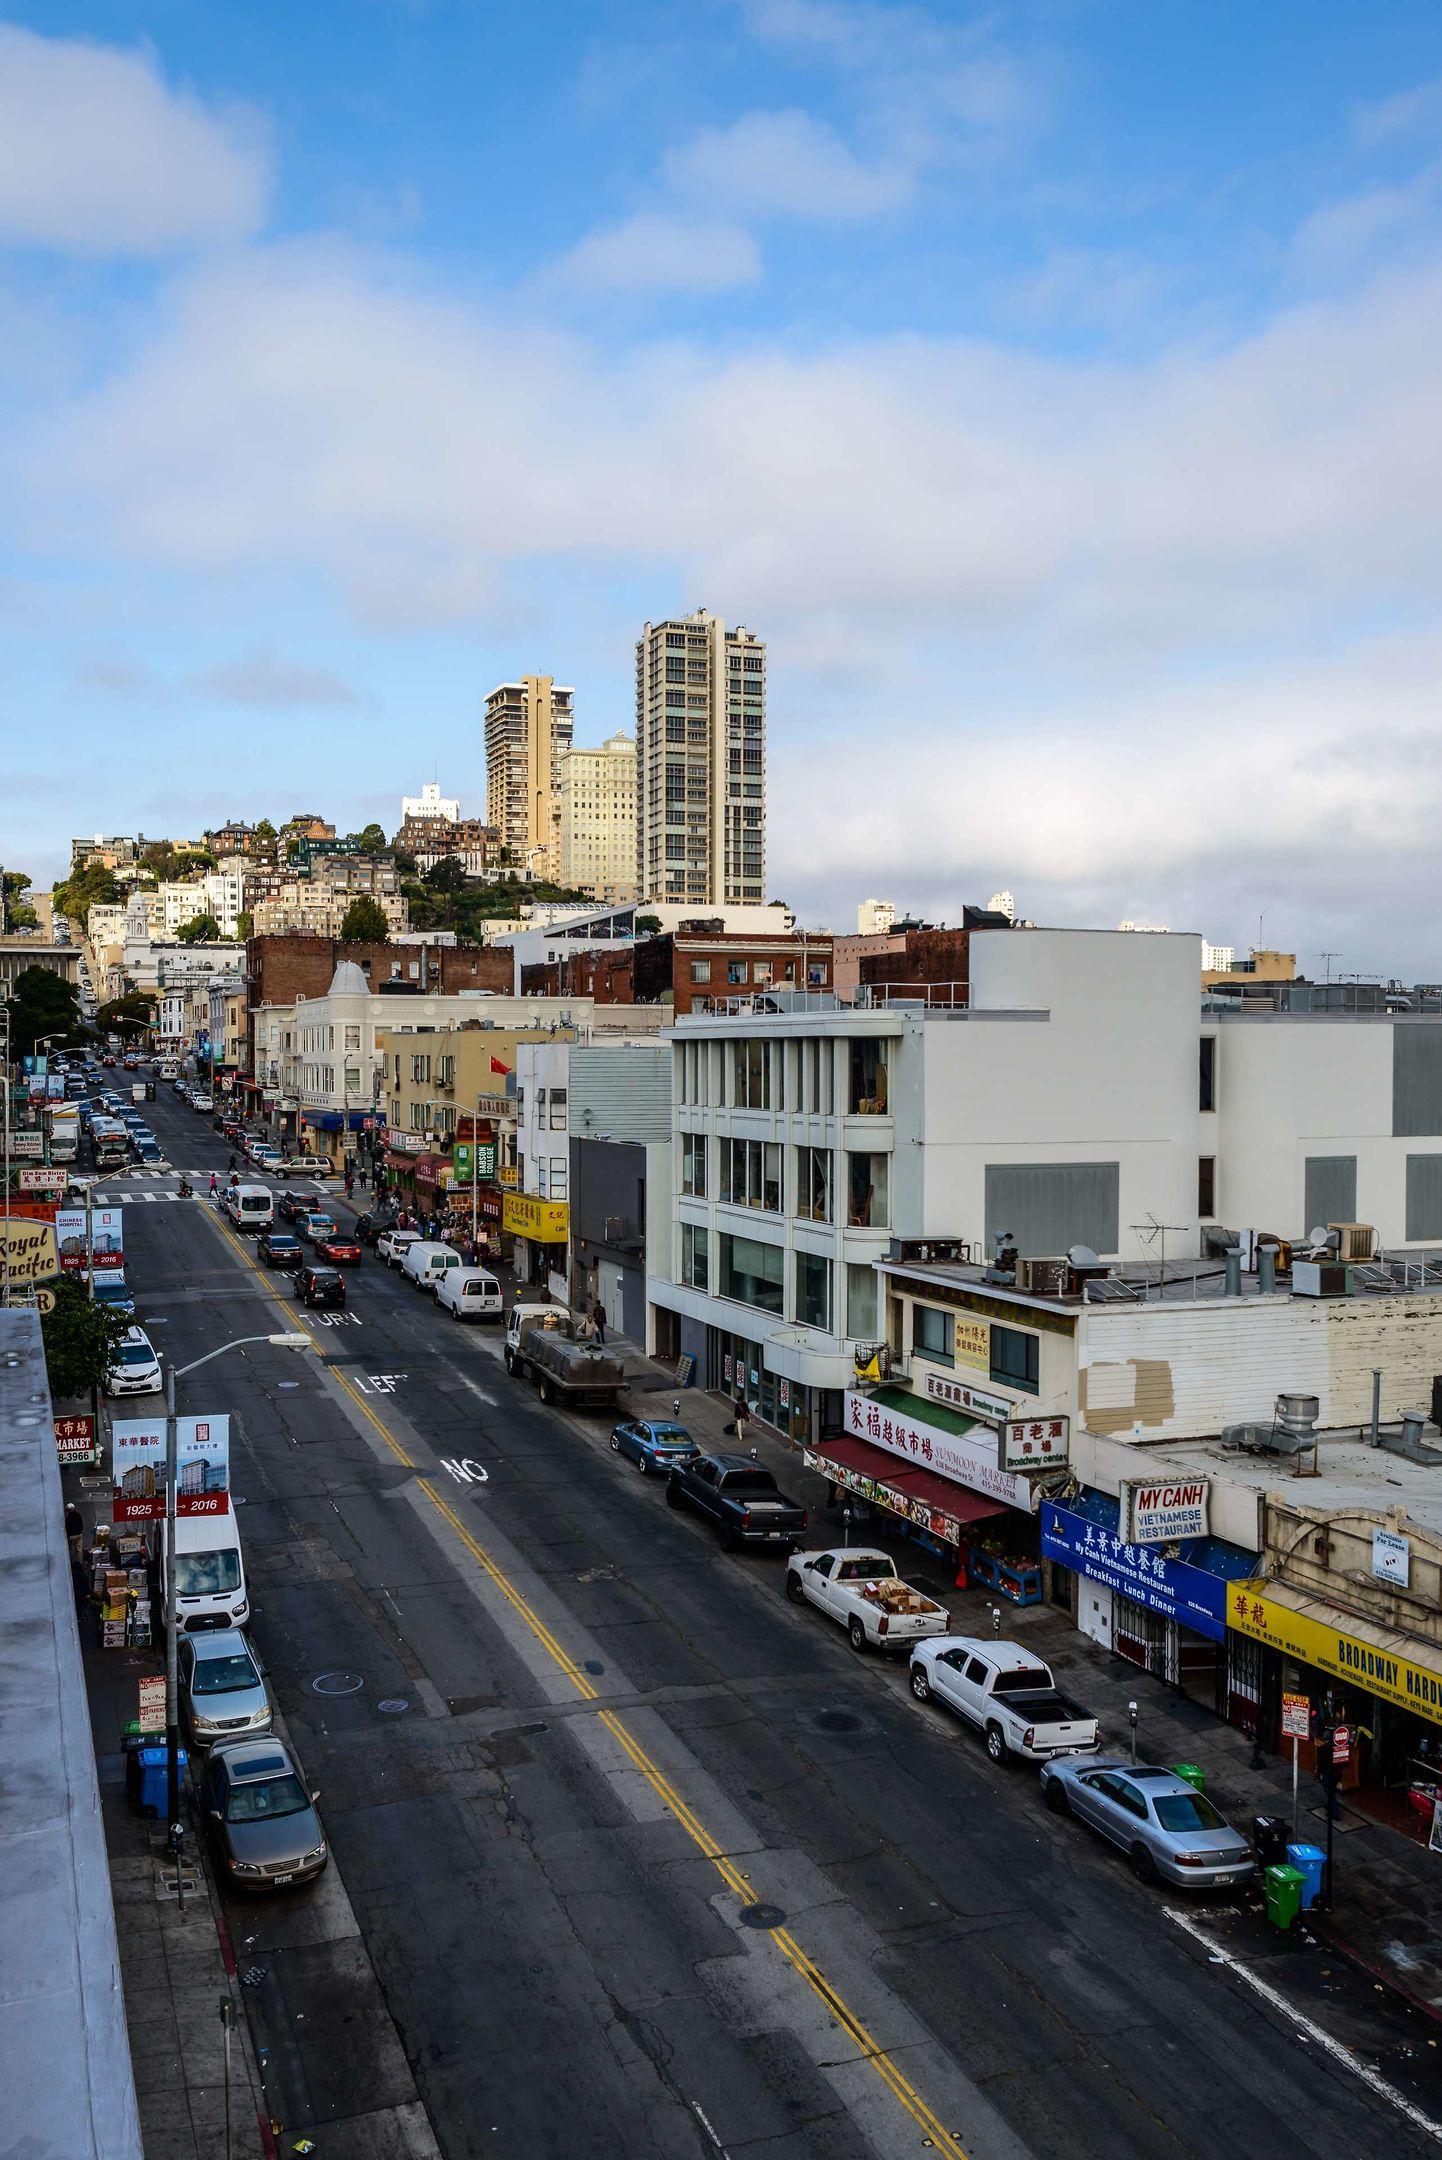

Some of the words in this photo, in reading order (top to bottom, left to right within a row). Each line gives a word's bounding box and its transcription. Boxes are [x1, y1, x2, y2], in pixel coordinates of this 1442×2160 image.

[478, 1146, 487, 1174] BABSON
[299, 1312, 362, 1327] TURN
[56, 1437, 90, 1450] MARKET
[440, 1458, 489, 1483] NO
[934, 1446, 977, 1473] SUNMOON
[979, 1466, 1018, 1490] MARKET
[1007, 1455, 1042, 1467] Broadway
[944, 1463, 968, 1481] Broadway
[126, 1505, 151, 1516] 1925
[191, 1500, 217, 1511] 2016
[1139, 1489, 1162, 1511] MY
[1162, 1485, 1204, 1507] CANH
[1137, 1509, 1202, 1526] VIETNAMESE
[1138, 1522, 1203, 1539] RESTAURANT
[1083, 1525, 1167, 1580] 美景中越餐館
[1376, 1535, 1387, 1545] For
[1388, 1540, 1405, 1552] Lease
[1075, 1541, 1084, 1556] My
[1084, 1545, 1100, 1563] Canh
[1101, 1553, 1137, 1578] Vietnamese
[1138, 1571, 1175, 1597] Restaurant
[1085, 1563, 1120, 1589] Breakfast
[1124, 1581, 1146, 1601] Lunch
[1150, 1593, 1176, 1616] Dinner
[1233, 1595, 1267, 1629] 華龍
[1338, 1639, 1398, 1687] BROADWAY
[1317, 1657, 1338, 1673] HARDWARE
[1366, 1678, 1392, 1696] RESTAURANT
[140, 1707, 148, 1715] NO
[1283, 1704, 1290, 1712] NO
